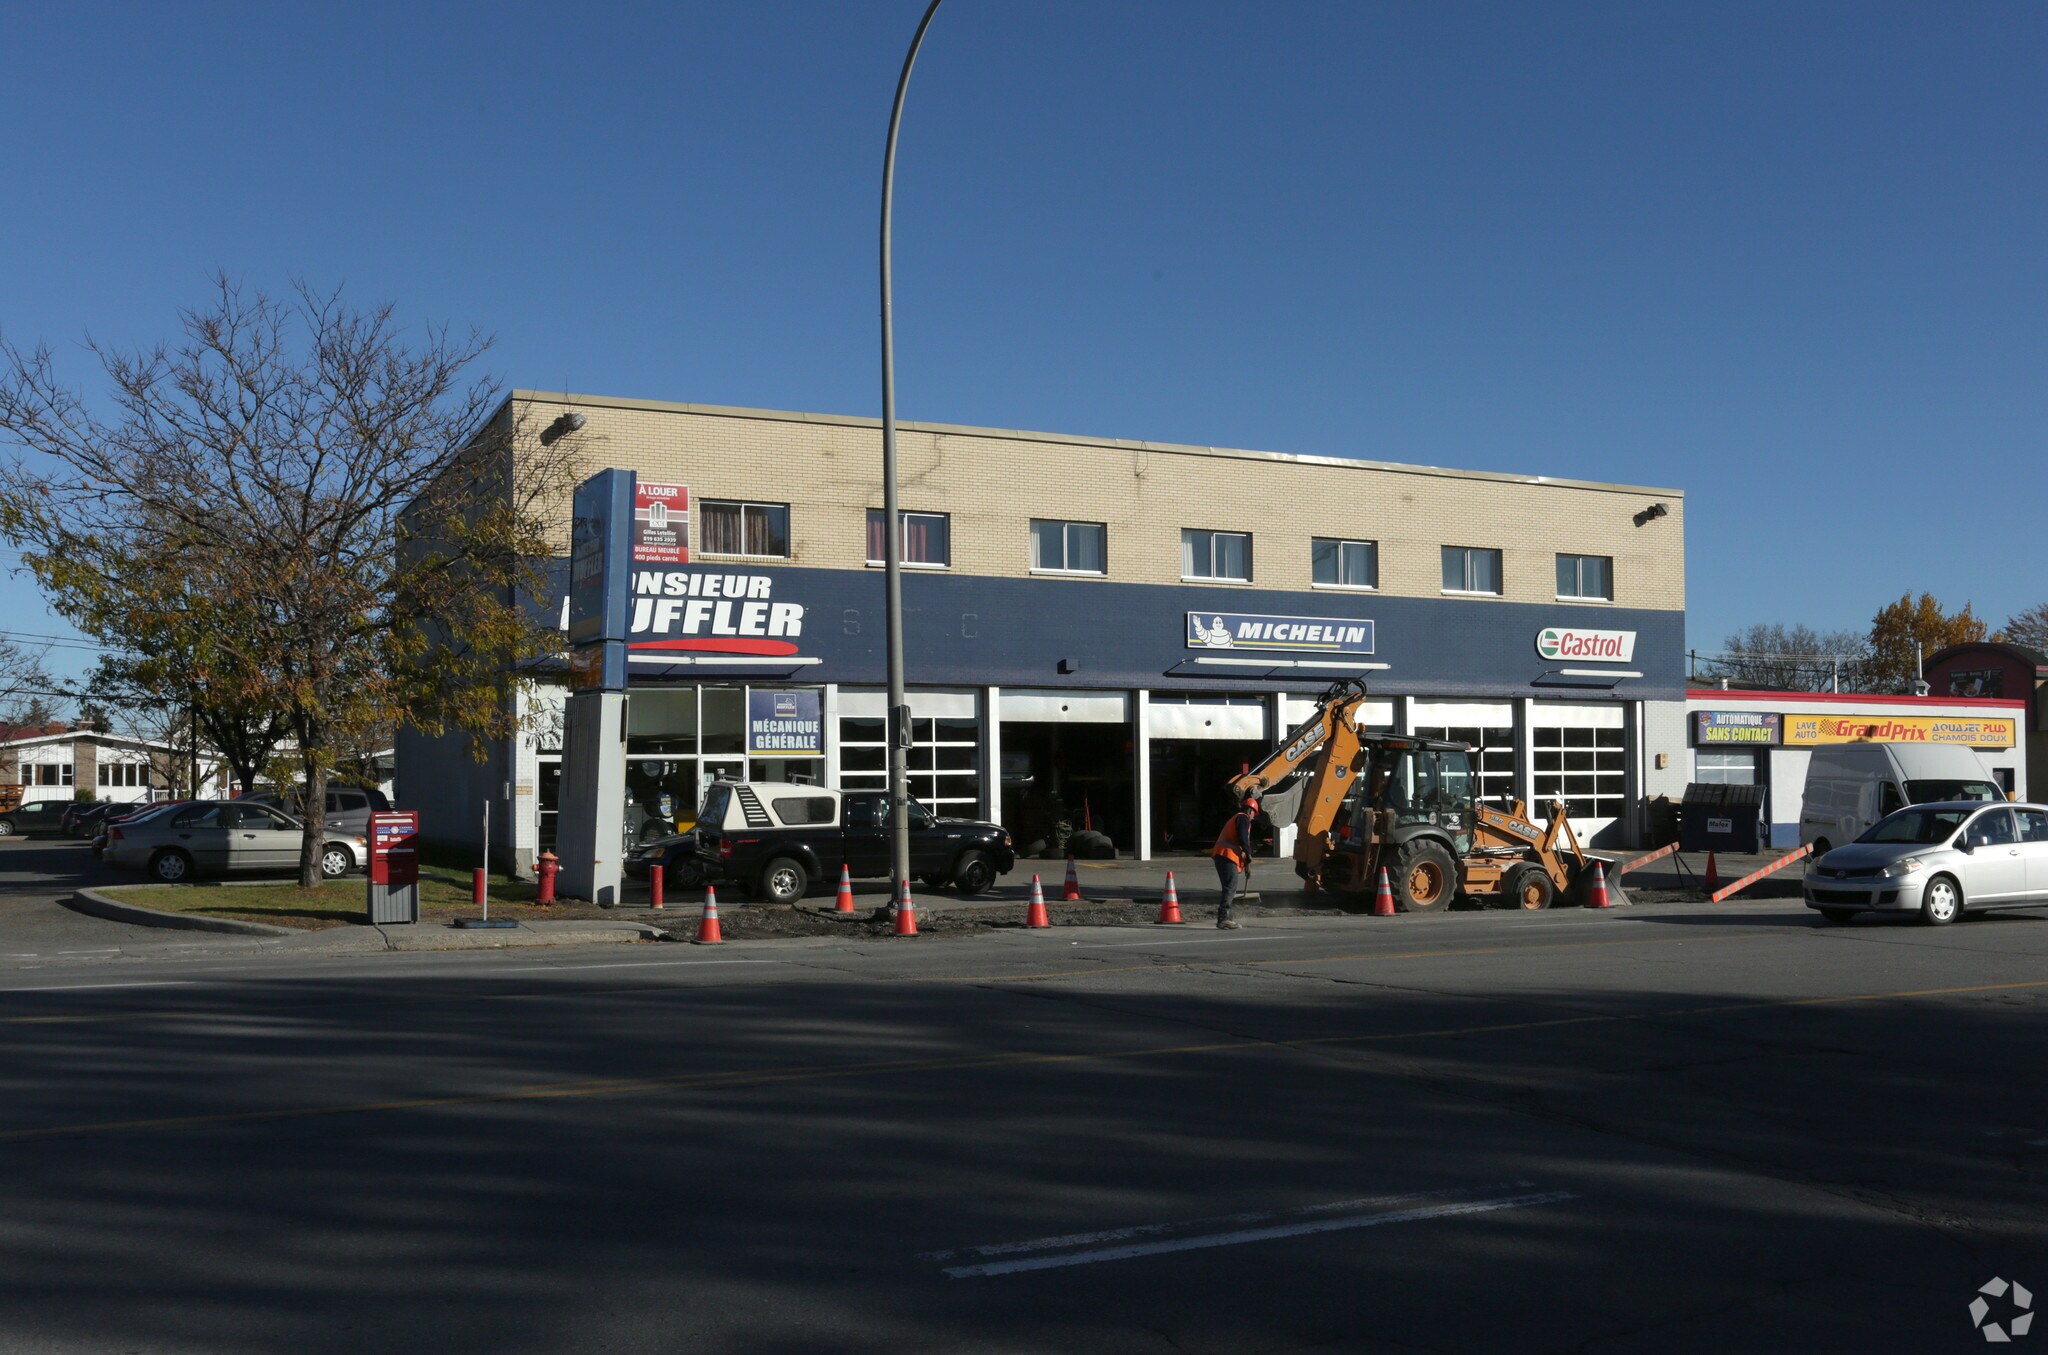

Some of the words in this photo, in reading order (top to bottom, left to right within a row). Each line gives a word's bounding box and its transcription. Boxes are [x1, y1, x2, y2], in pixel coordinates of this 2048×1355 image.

[639, 484, 647, 495] À
[648, 486, 678, 497] LOUER
[632, 571, 772, 598] NSIEUR
[559, 596, 804, 637] UFFLER
[1236, 621, 1365, 643] MICHELIN
[1560, 632, 1625, 658] Castrol
[752, 718, 819, 734] MÉCANIQUE
[1716, 714, 1762, 726] AUTOMATIQUE
[1796, 721, 1817, 730] LAVE
[1931, 723, 1981, 732] AQUAJET
[1983, 723, 2007, 733] PLUS
[756, 733, 816, 749] GÉNÉRALE
[1285, 721, 1326, 762] CASE
[1705, 727, 1731, 741] SANS
[1732, 727, 1773, 741] CONTACT
[1795, 730, 1817, 739] AUTO
[1931, 733, 1977, 742] CHAMOIS
[1980, 734, 2007, 742] DOUX
[1508, 821, 1540, 840] CASE
